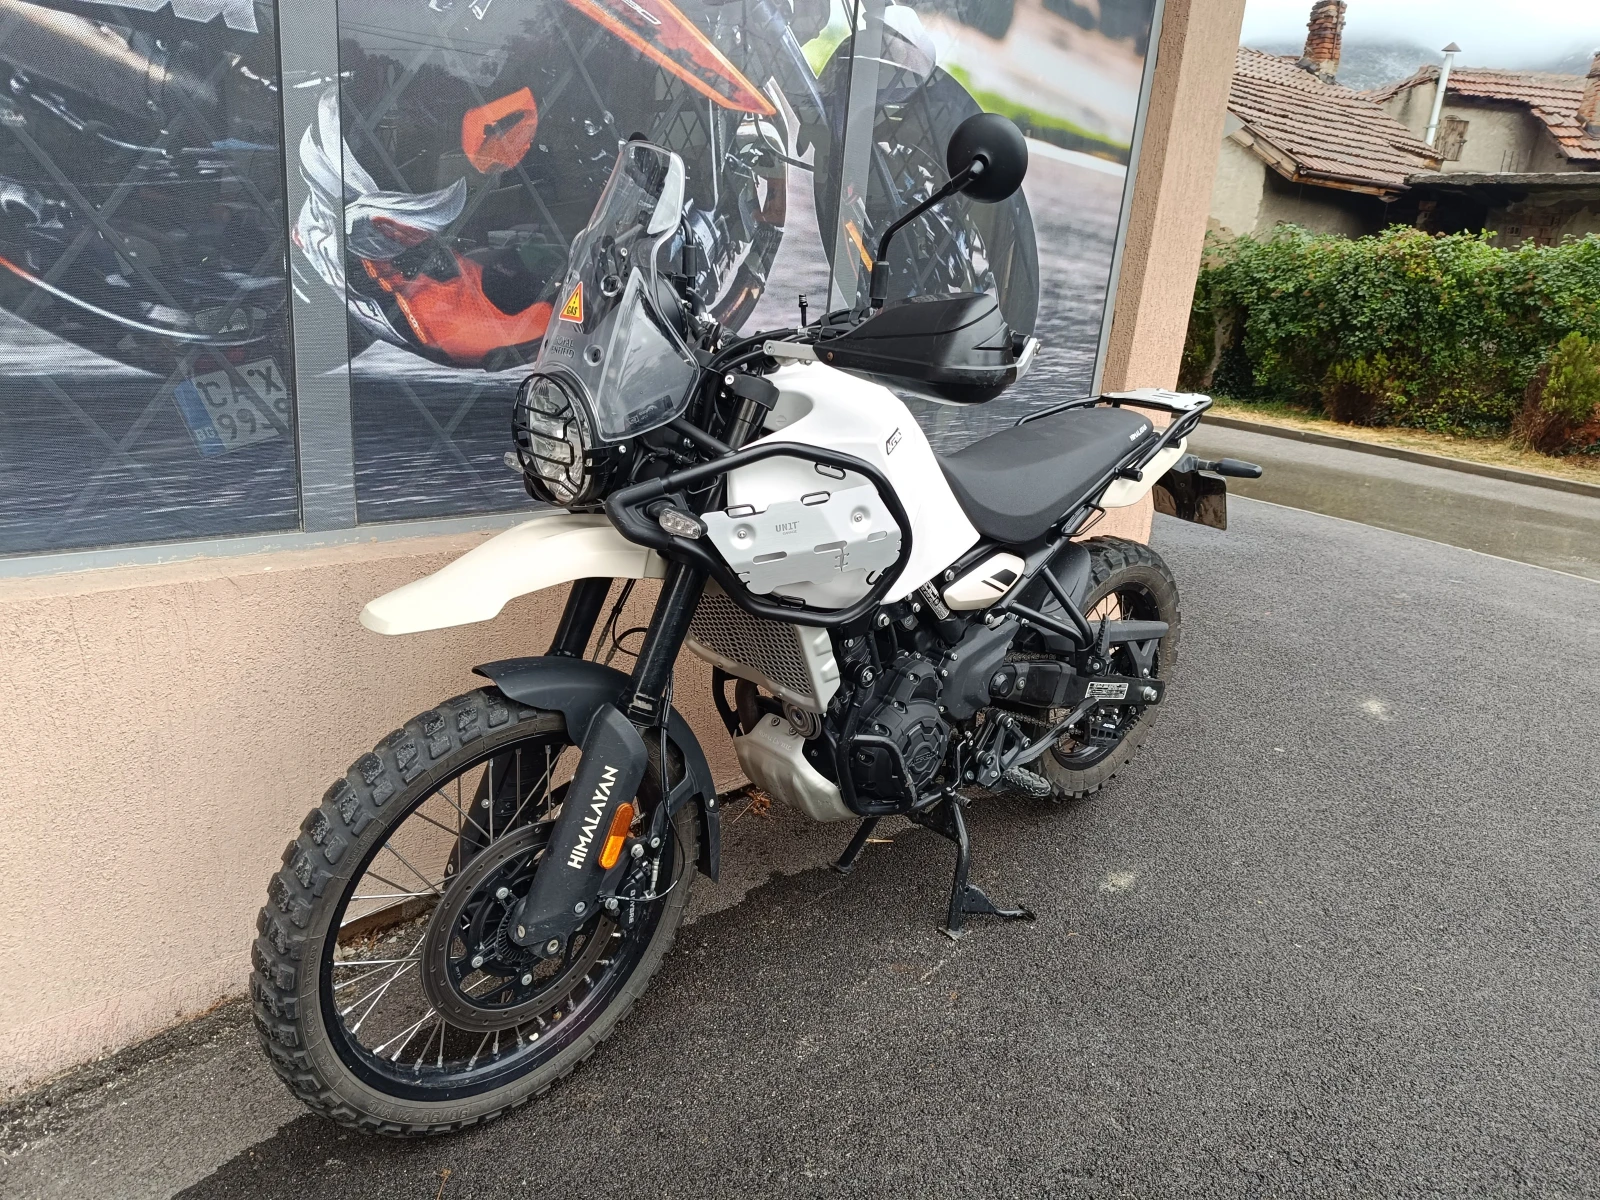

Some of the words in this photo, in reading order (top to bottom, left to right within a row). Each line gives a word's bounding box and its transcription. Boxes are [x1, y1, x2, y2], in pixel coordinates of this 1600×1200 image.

[566, 305, 578, 316] GAS
[217, 397, 293, 441] 999
[775, 521, 798, 532] UNIT
[567, 764, 619, 870] HIMALAYAN
